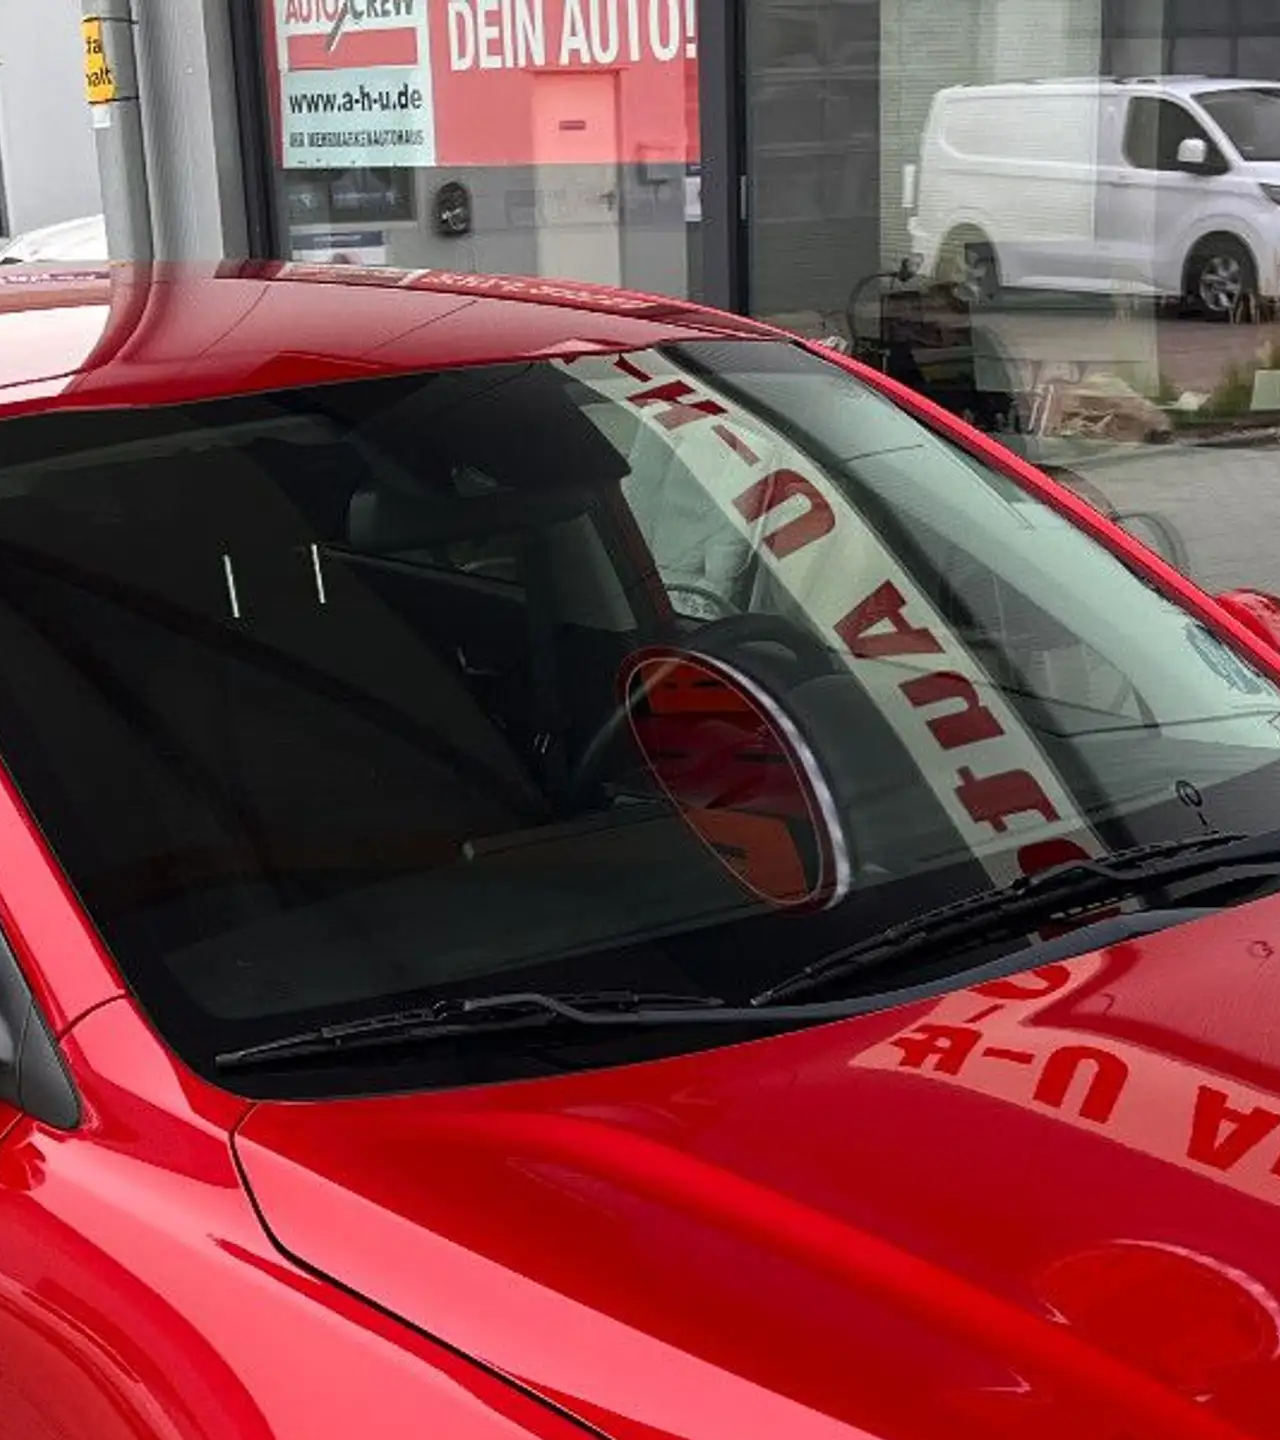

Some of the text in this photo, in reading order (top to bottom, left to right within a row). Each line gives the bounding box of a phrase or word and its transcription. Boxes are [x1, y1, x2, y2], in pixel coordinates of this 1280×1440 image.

[448, 0, 697, 71] DEIN AUTO!
[289, 83, 423, 114] www.a-h-u.de
